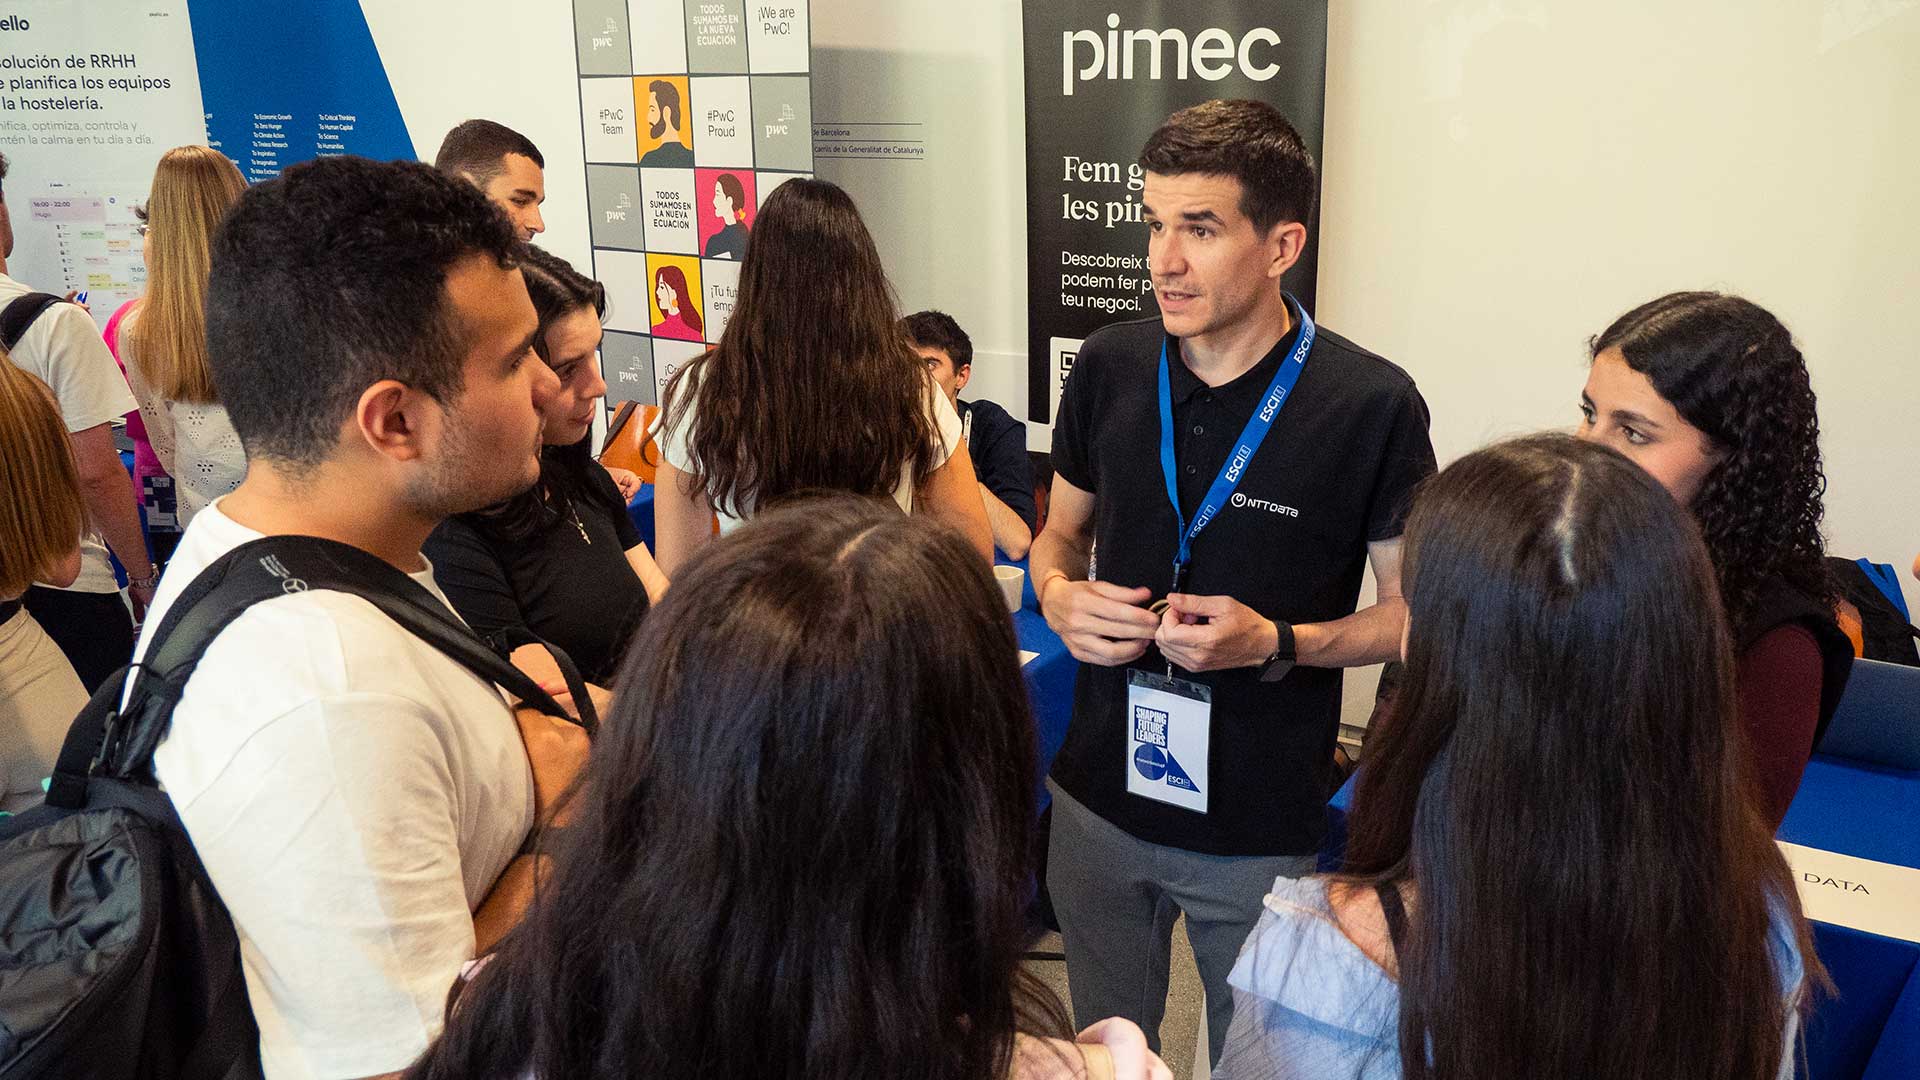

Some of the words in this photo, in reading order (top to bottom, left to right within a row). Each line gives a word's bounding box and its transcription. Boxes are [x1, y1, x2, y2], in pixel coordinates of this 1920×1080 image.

[700, 4, 725, 14] TODOS
[779, 8, 796, 19] are
[0, 15, 30, 31] ello
[692, 15, 728, 25] SUMAMOS
[728, 14, 739, 24] EN
[698, 25, 709, 35] LA
[709, 24, 736, 34] NUEVA
[764, 22, 791, 35] PwC!
[592, 36, 613, 50] pwc
[1063, 13, 1281, 95] pimec
[65, 54, 86, 69] de
[90, 54, 137, 69] RRHH
[9, 75, 77, 92] planifica
[81, 75, 104, 90] los
[108, 75, 171, 92] equipos
[2, 96, 16, 110] la
[20, 96, 103, 110] hostelería.
[600, 109, 624, 121] #PwC
[707, 110, 735, 122] #PwC
[84, 121, 129, 131] controla
[601, 123, 624, 135] Team
[708, 125, 736, 138] Proud
[766, 124, 789, 137] pwc
[821, 128, 850, 137] Barcelona
[28, 135, 39, 145] la
[40, 135, 74, 145] calma
[76, 136, 91, 145] en
[93, 135, 105, 145] tu
[833, 145, 841, 153] de
[848, 145, 882, 154] Generalitat
[883, 146, 892, 154] de
[893, 146, 924, 156] Catalunya
[1063, 156, 1120, 183] Fem
[655, 190, 680, 200] TODOS
[650, 200, 682, 210] SUMAMOS
[682, 201, 692, 211] EN
[1062, 193, 1099, 221] les
[606, 210, 626, 222] pwc
[654, 209, 665, 218] LA
[665, 210, 689, 219] NUEVA
[1061, 250, 1143, 270] Descobreix
[1061, 273, 1114, 289] podem
[1117, 275, 1138, 290] fer
[713, 301, 734, 314] emp
[1061, 293, 1083, 306] teu
[1087, 296, 1142, 314] negoci.
[1293, 337, 1311, 364] ESCI
[619, 370, 639, 382] pwc
[1259, 395, 1280, 423] ESCI
[1224, 455, 1246, 483] ESCI
[1136, 707, 1167, 725] SHAPING
[1138, 718, 1165, 736] FUTURE
[1136, 728, 1166, 747] LEADERS
[1167, 775, 1184, 785] ESCI
[1804, 873, 1870, 895] DATA
